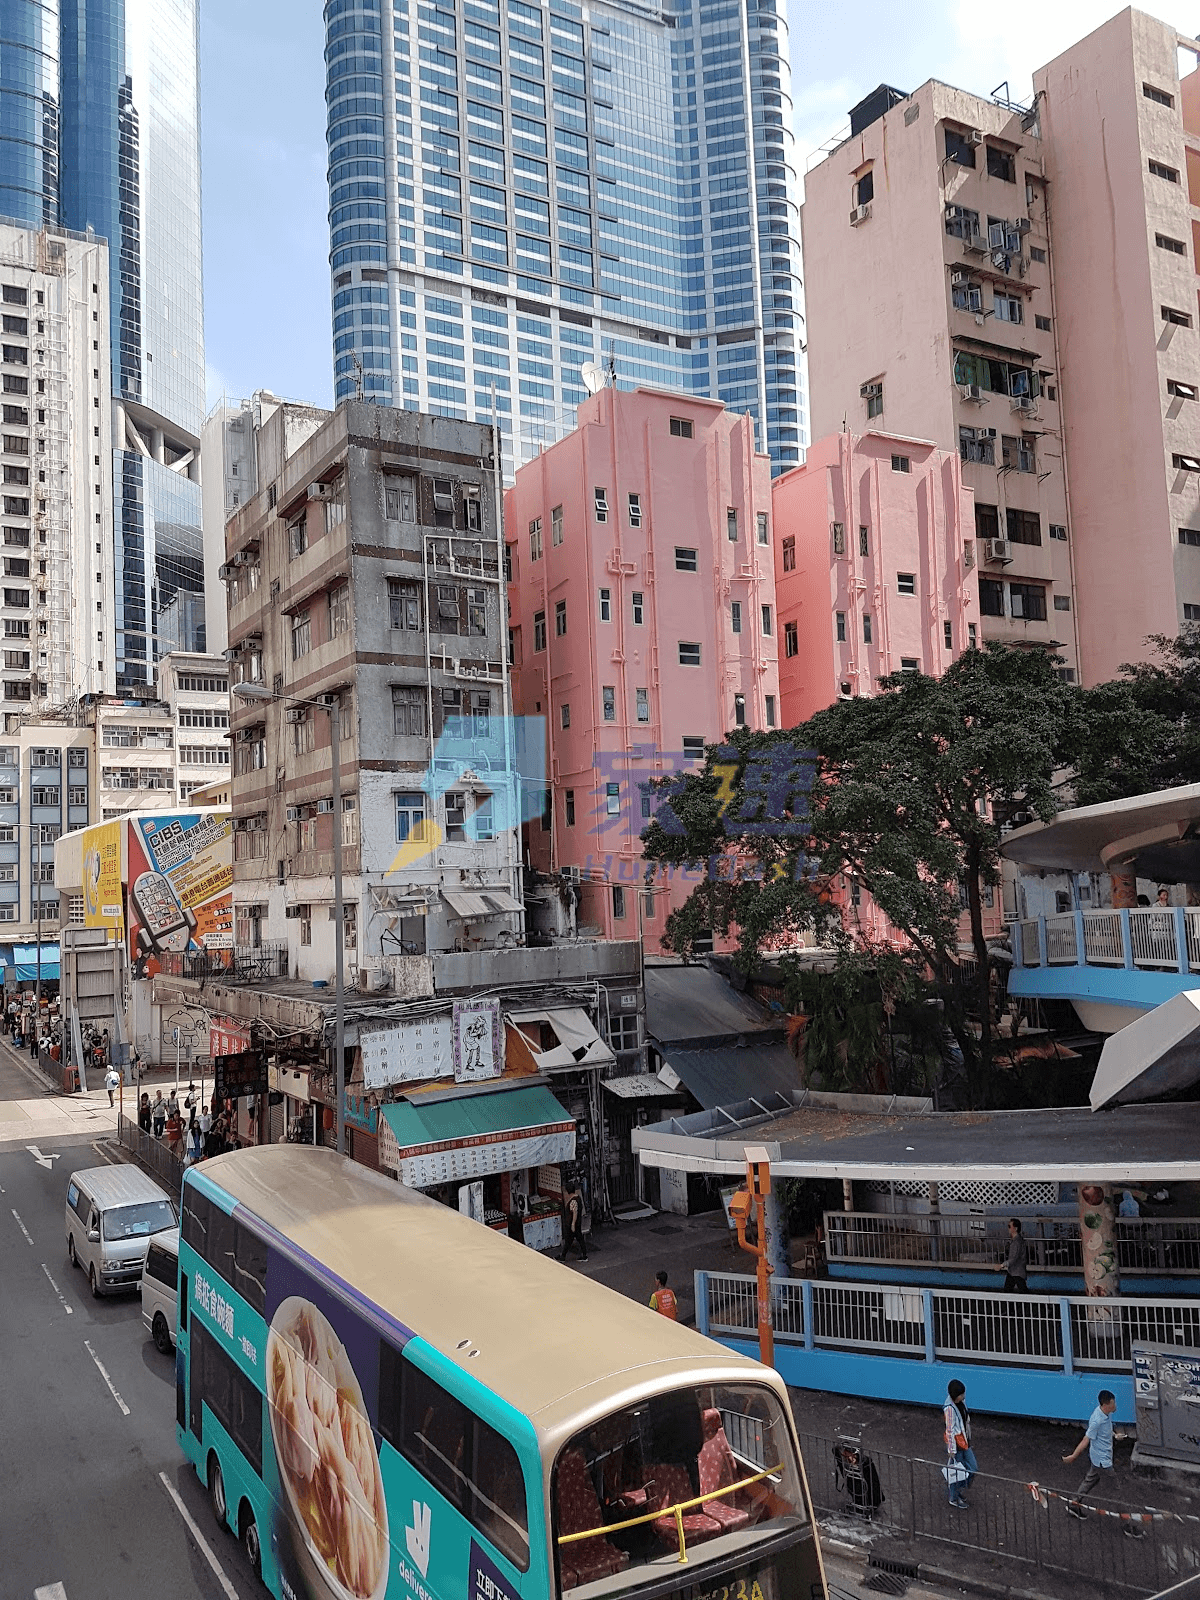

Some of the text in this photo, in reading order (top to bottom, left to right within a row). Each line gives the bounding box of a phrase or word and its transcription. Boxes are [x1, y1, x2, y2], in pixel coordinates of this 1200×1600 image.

[149, 821, 183, 848] CIBS
[158, 819, 230, 864] Community Involvement
[160, 845, 201, 871] Broadcasting
[201, 830, 225, 847] Service
